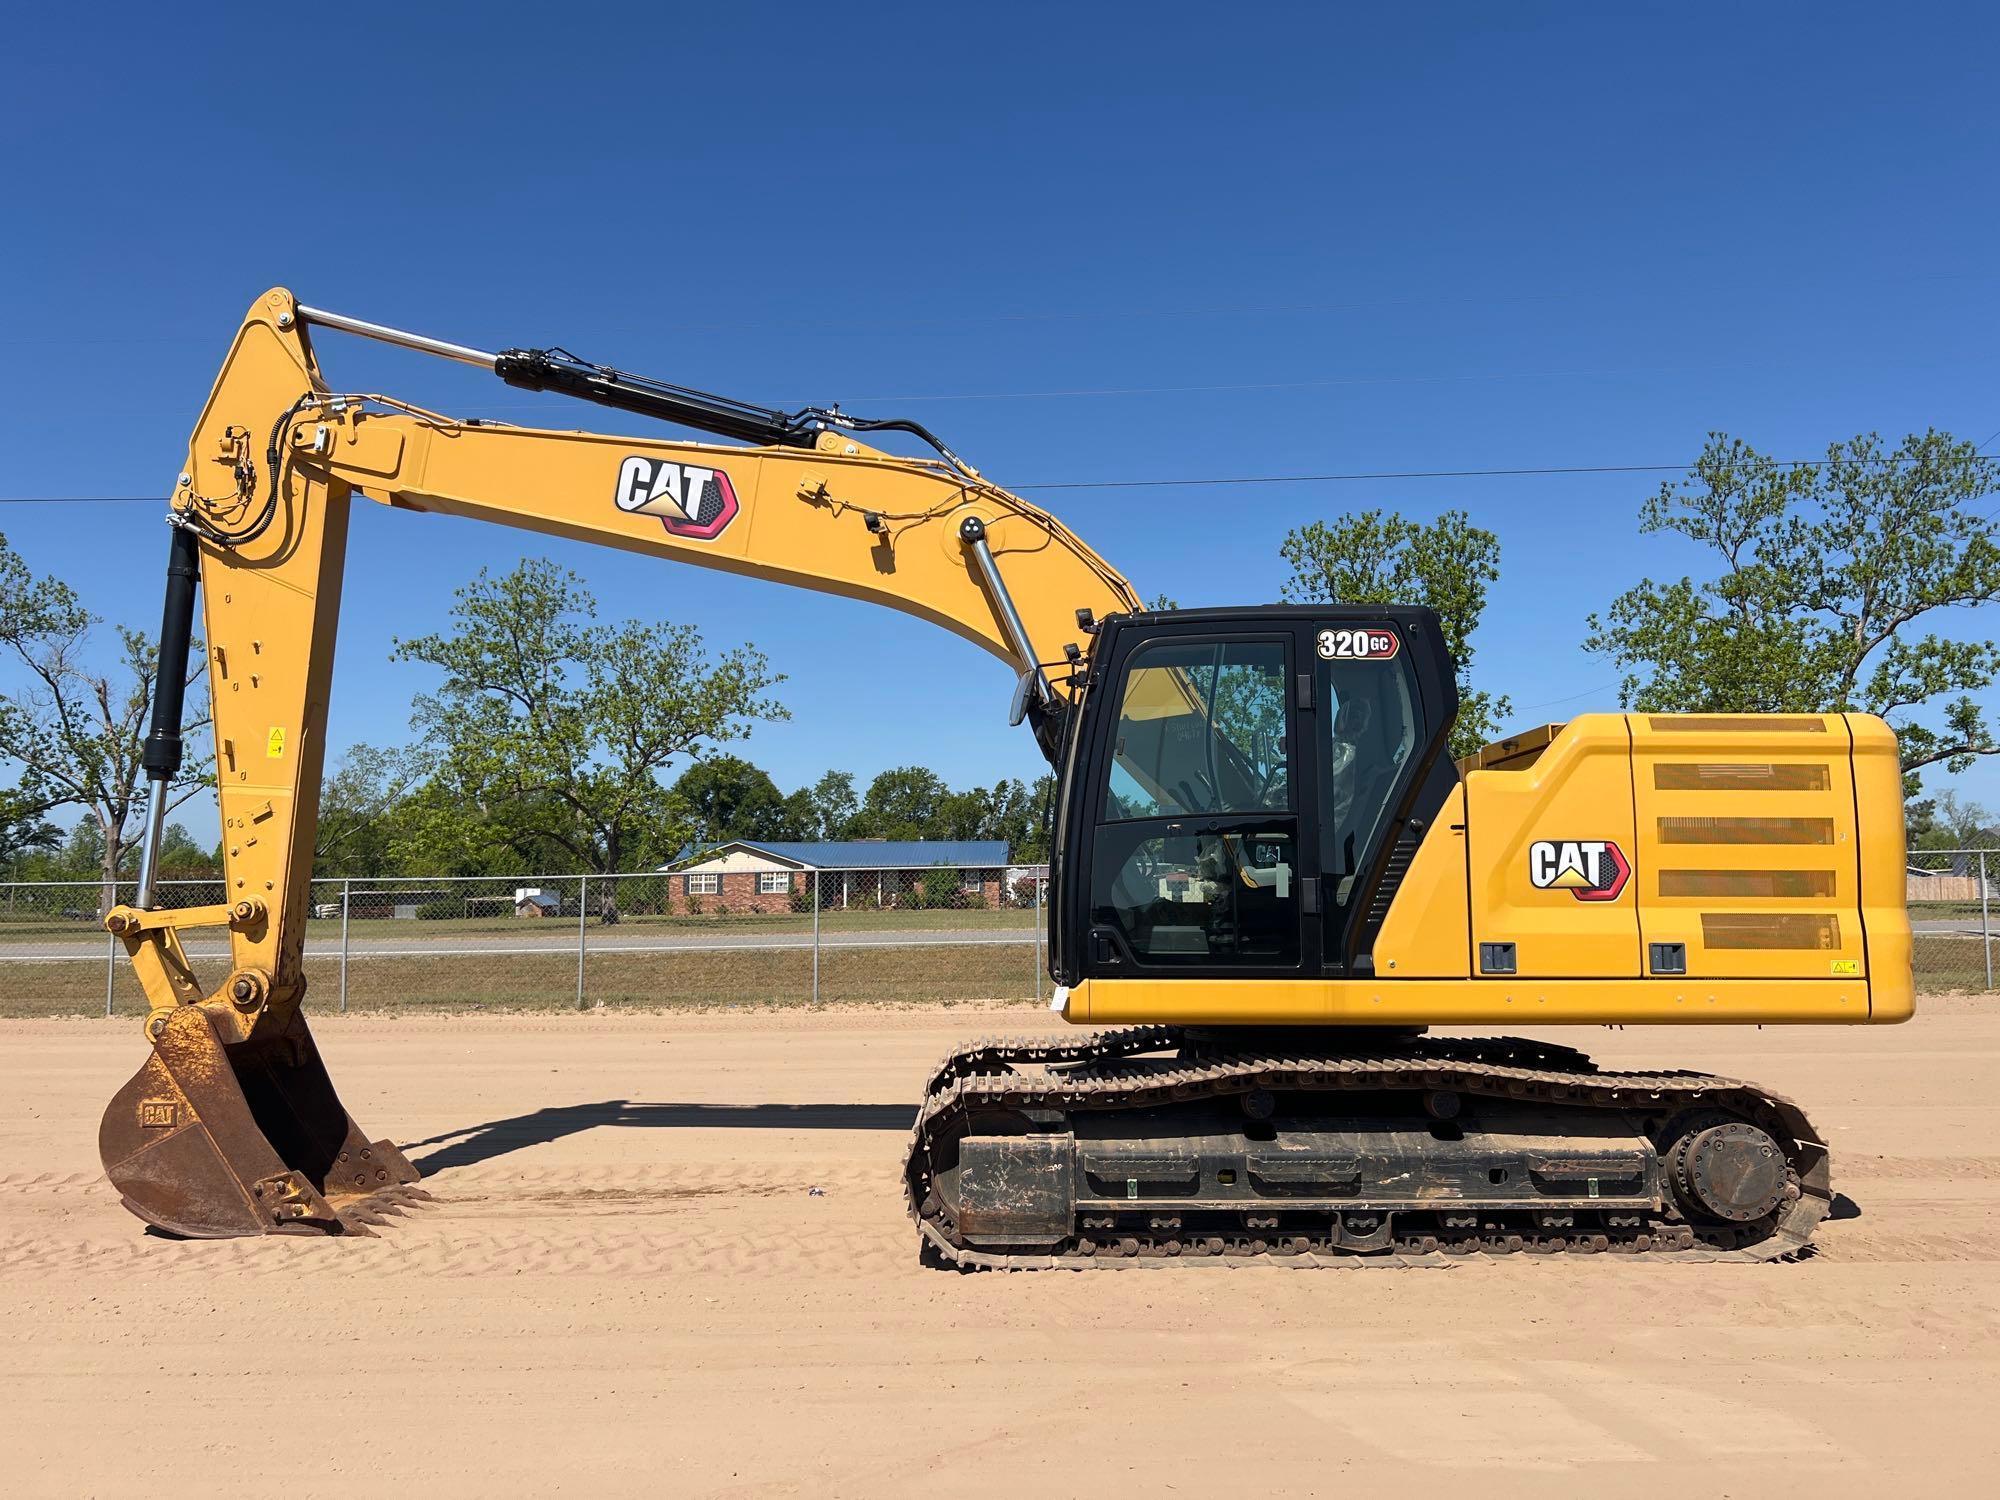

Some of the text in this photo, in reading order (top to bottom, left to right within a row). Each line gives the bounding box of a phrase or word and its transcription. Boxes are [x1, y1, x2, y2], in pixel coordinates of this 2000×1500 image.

[617, 456, 714, 521] CAT
[1319, 630, 1389, 657] 320 GC
[1530, 841, 1605, 887] CAT
[144, 1105, 174, 1125] CAT
